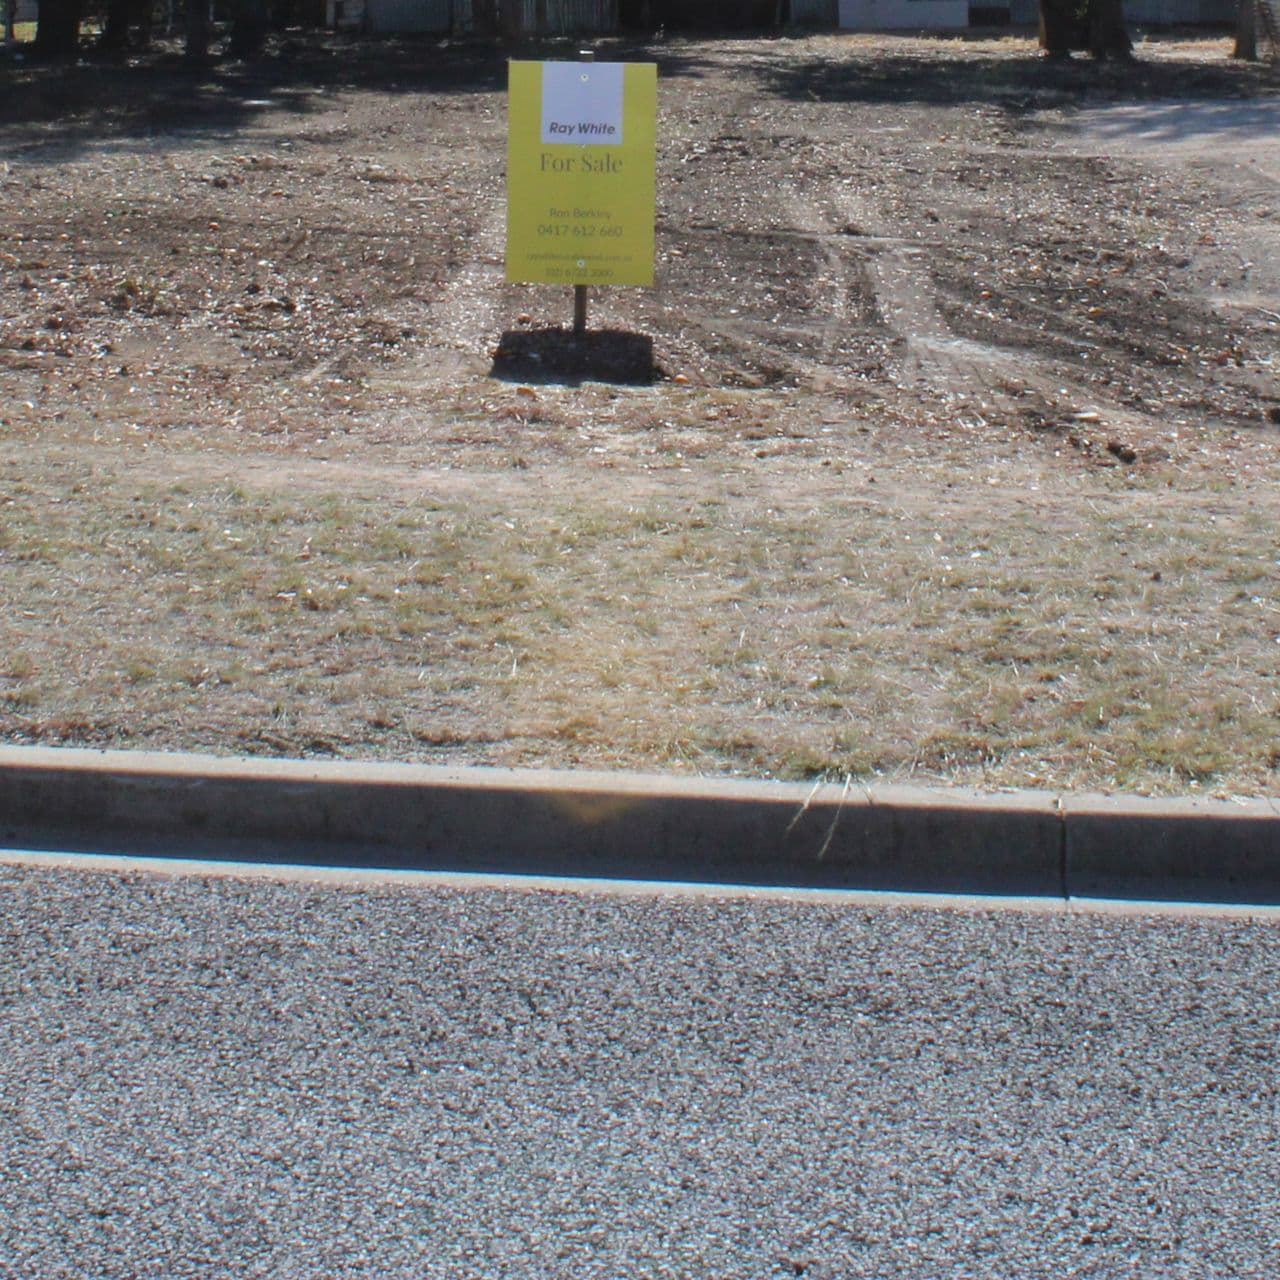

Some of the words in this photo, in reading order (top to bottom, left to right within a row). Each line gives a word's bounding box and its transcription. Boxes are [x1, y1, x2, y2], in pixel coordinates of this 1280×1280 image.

[549, 121, 575, 136] Ray
[578, 122, 616, 135] White
[540, 153, 575, 172] For
[581, 152, 623, 173] Sale
